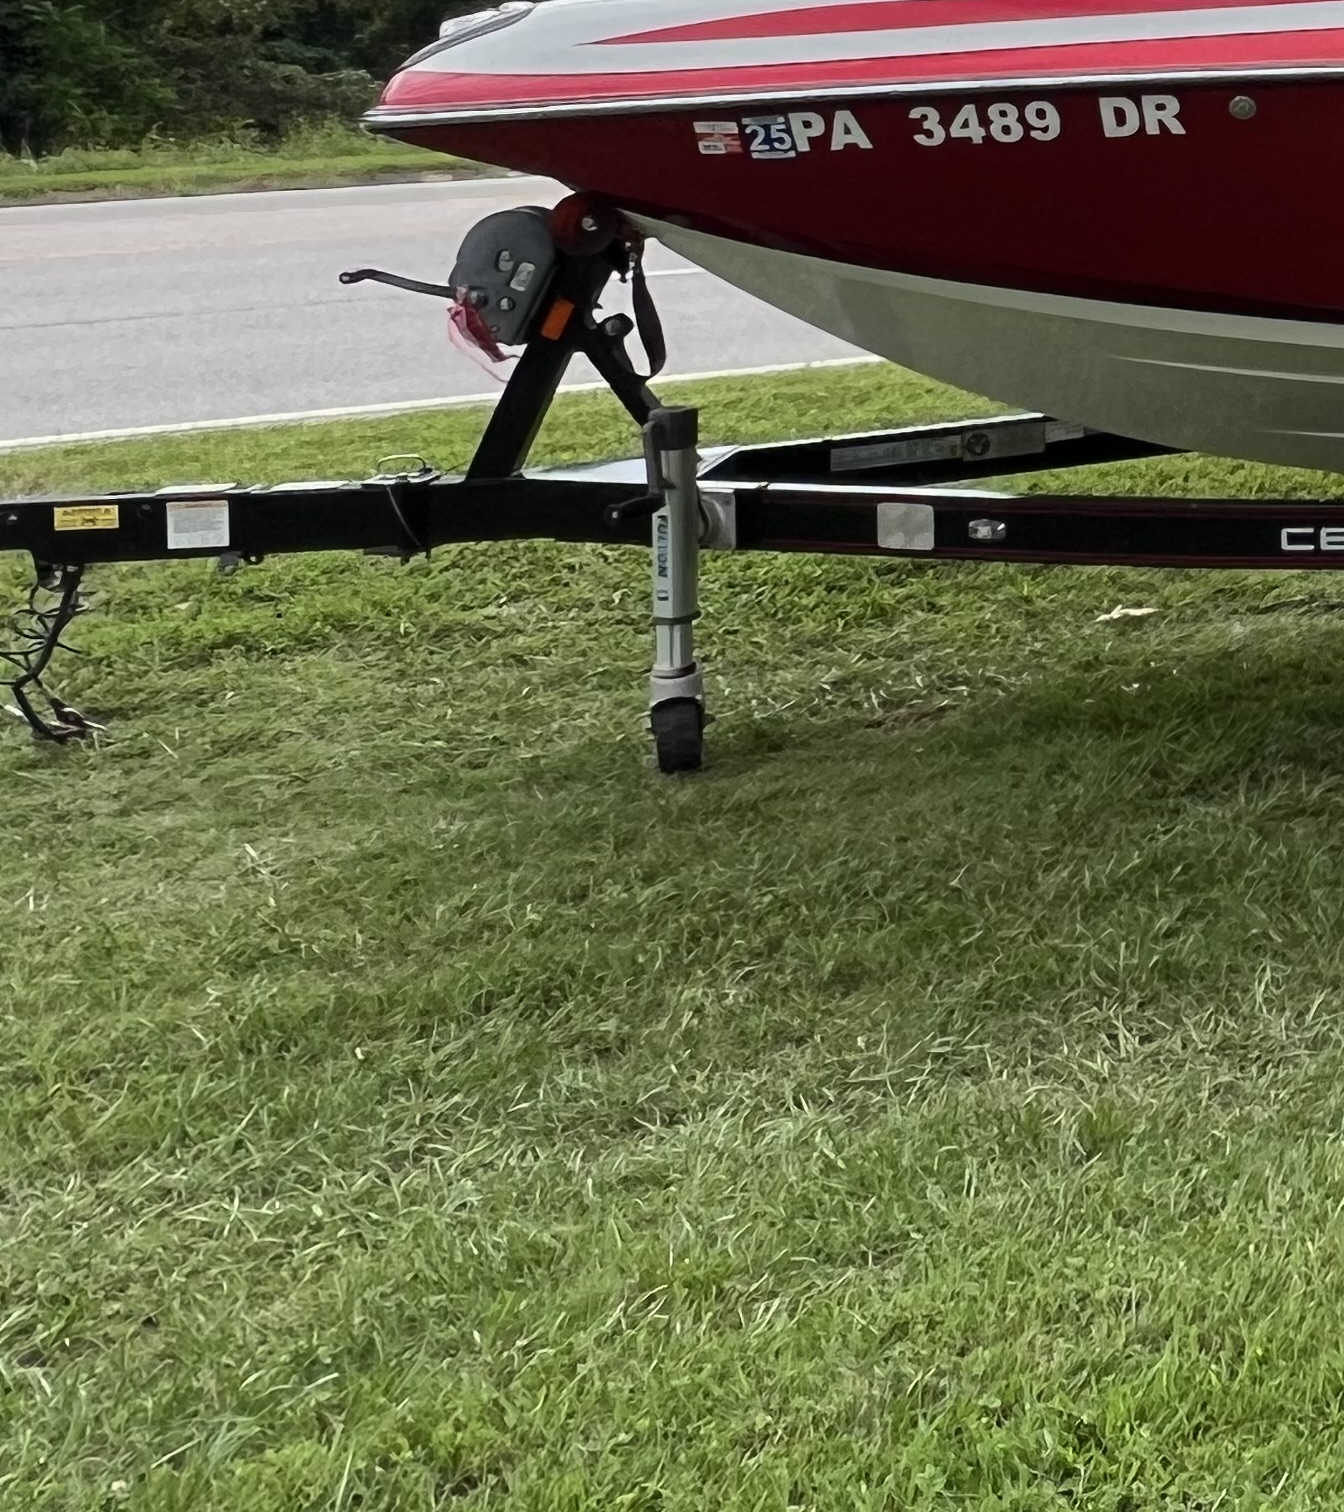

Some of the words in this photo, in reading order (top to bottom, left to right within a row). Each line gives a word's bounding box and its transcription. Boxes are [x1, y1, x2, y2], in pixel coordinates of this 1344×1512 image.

[745, 124, 793, 151] 25
[788, 110, 873, 152] PA
[908, 100, 1061, 147] 3489
[1099, 94, 1186, 138] DR
